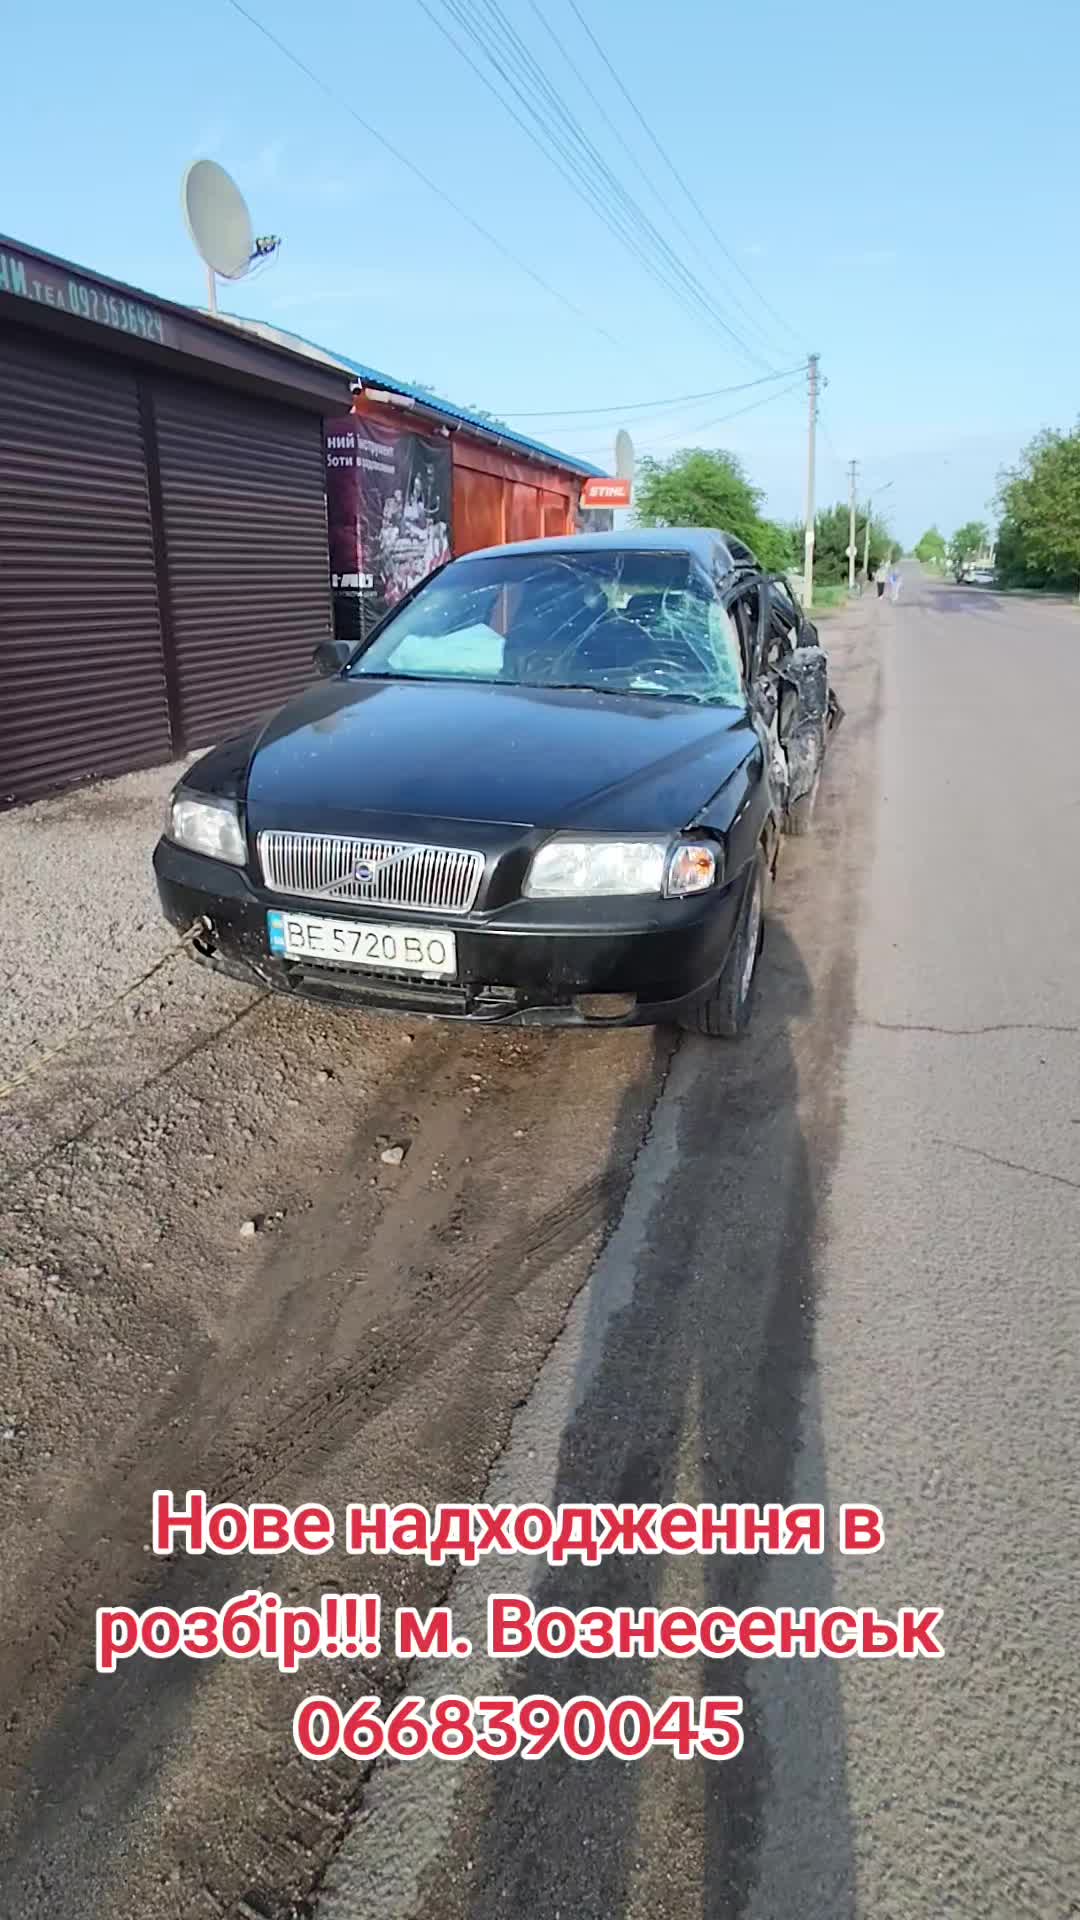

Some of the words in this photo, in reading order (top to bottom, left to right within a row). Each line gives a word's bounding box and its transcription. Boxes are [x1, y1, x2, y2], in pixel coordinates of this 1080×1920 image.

[588, 486, 625, 497] STIHL
[287, 922, 325, 952] BE
[333, 928, 396, 961] 5720
[404, 937, 446, 966] BO
